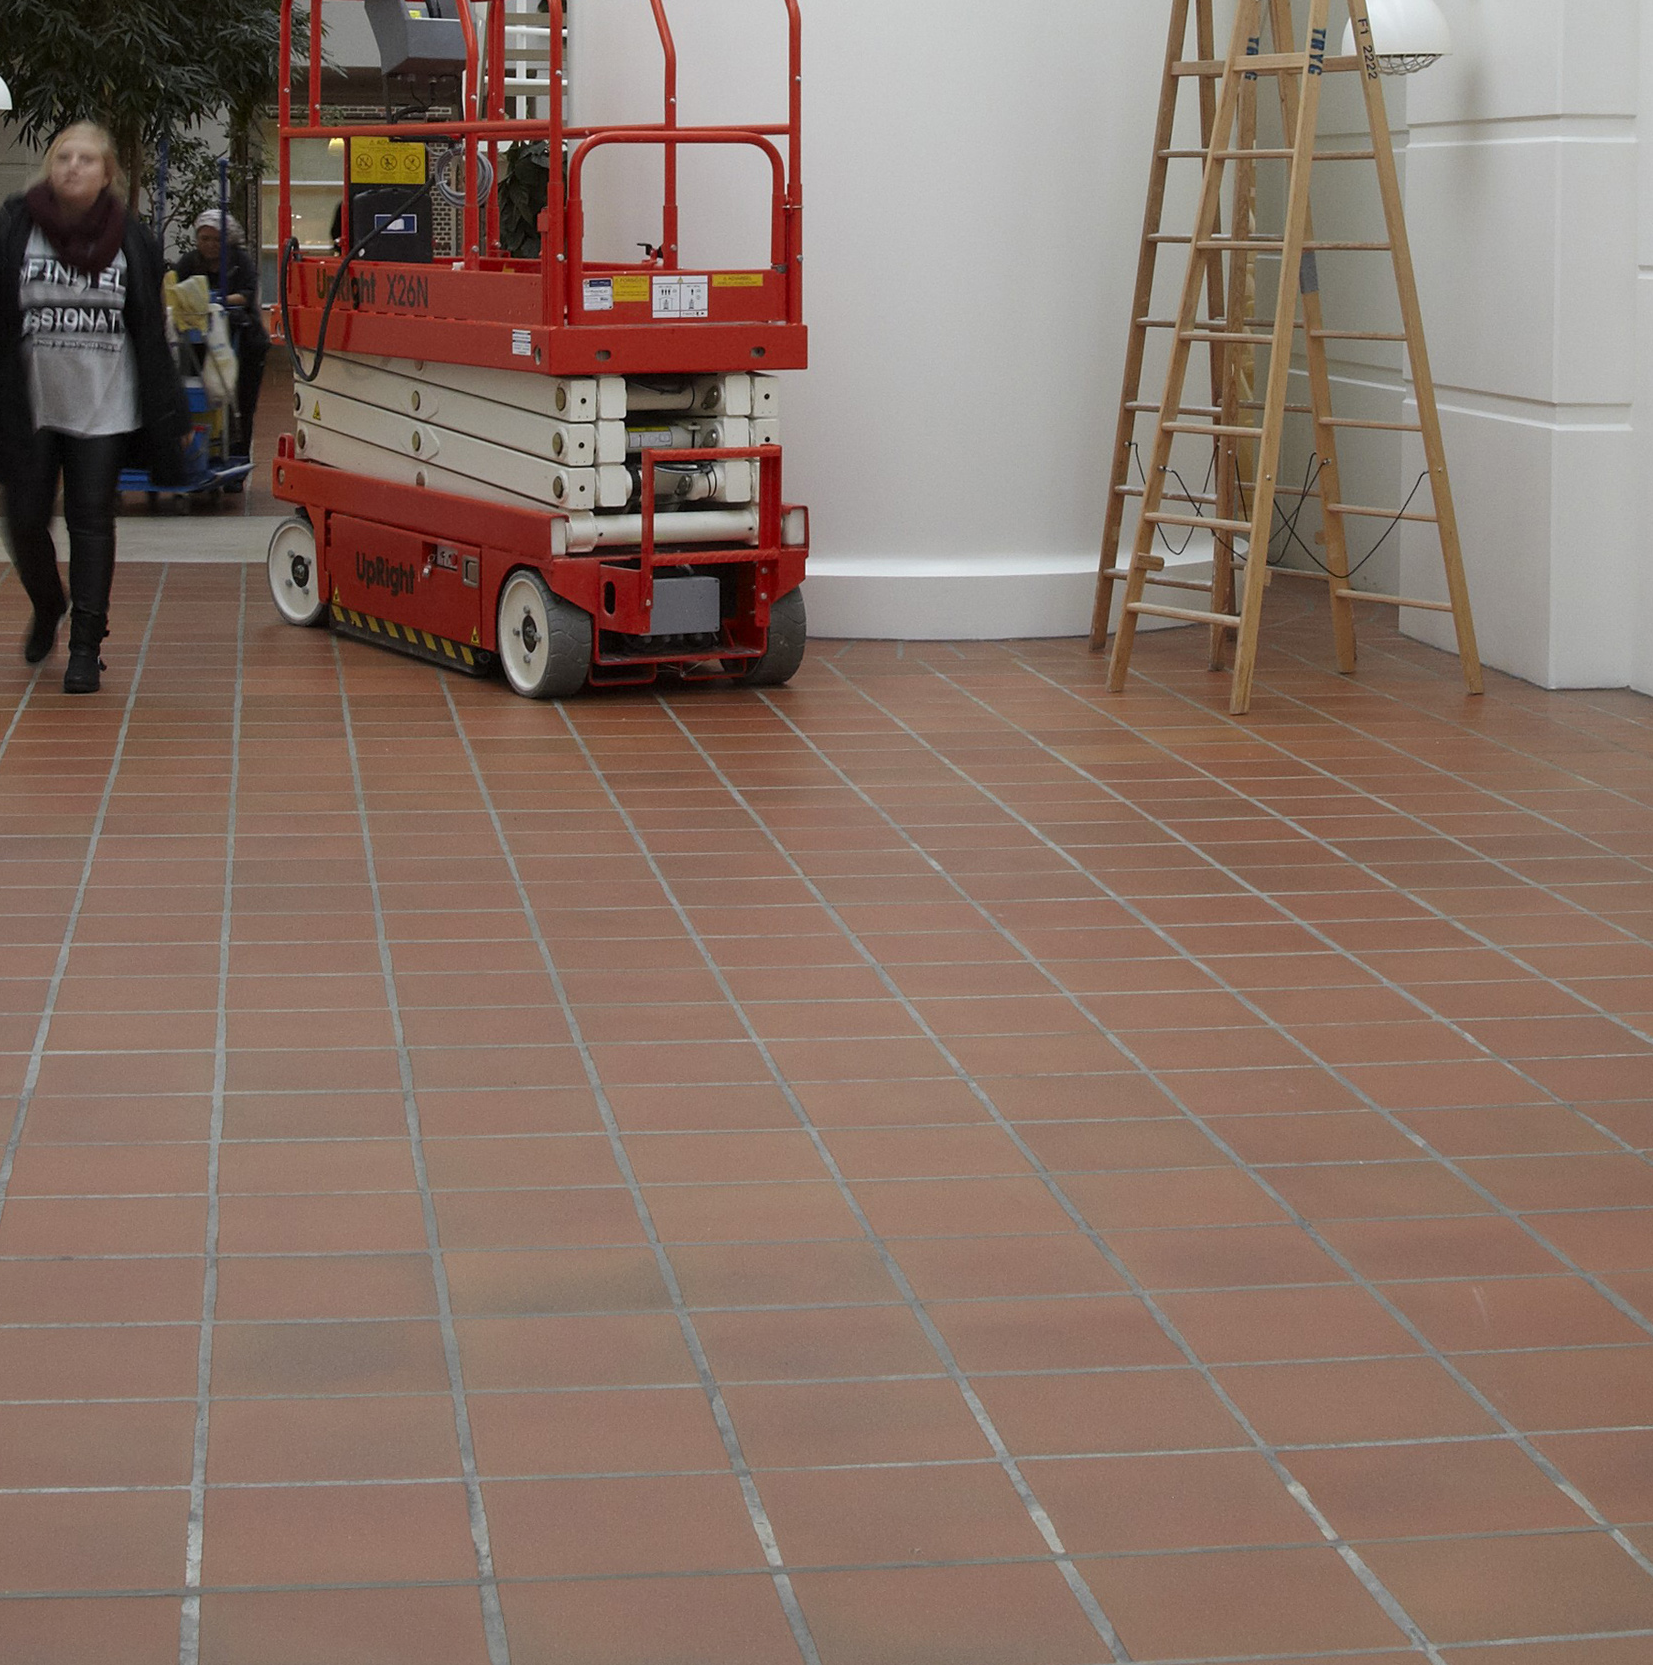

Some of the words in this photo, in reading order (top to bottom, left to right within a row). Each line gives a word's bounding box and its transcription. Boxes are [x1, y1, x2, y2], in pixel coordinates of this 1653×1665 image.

[1245, 37, 1260, 81] TRG
[1308, 28, 1326, 76] TRYG
[1363, 45, 1378, 80] 2222
[387, 273, 429, 309] X26N
[355, 551, 415, 597] UpRight
